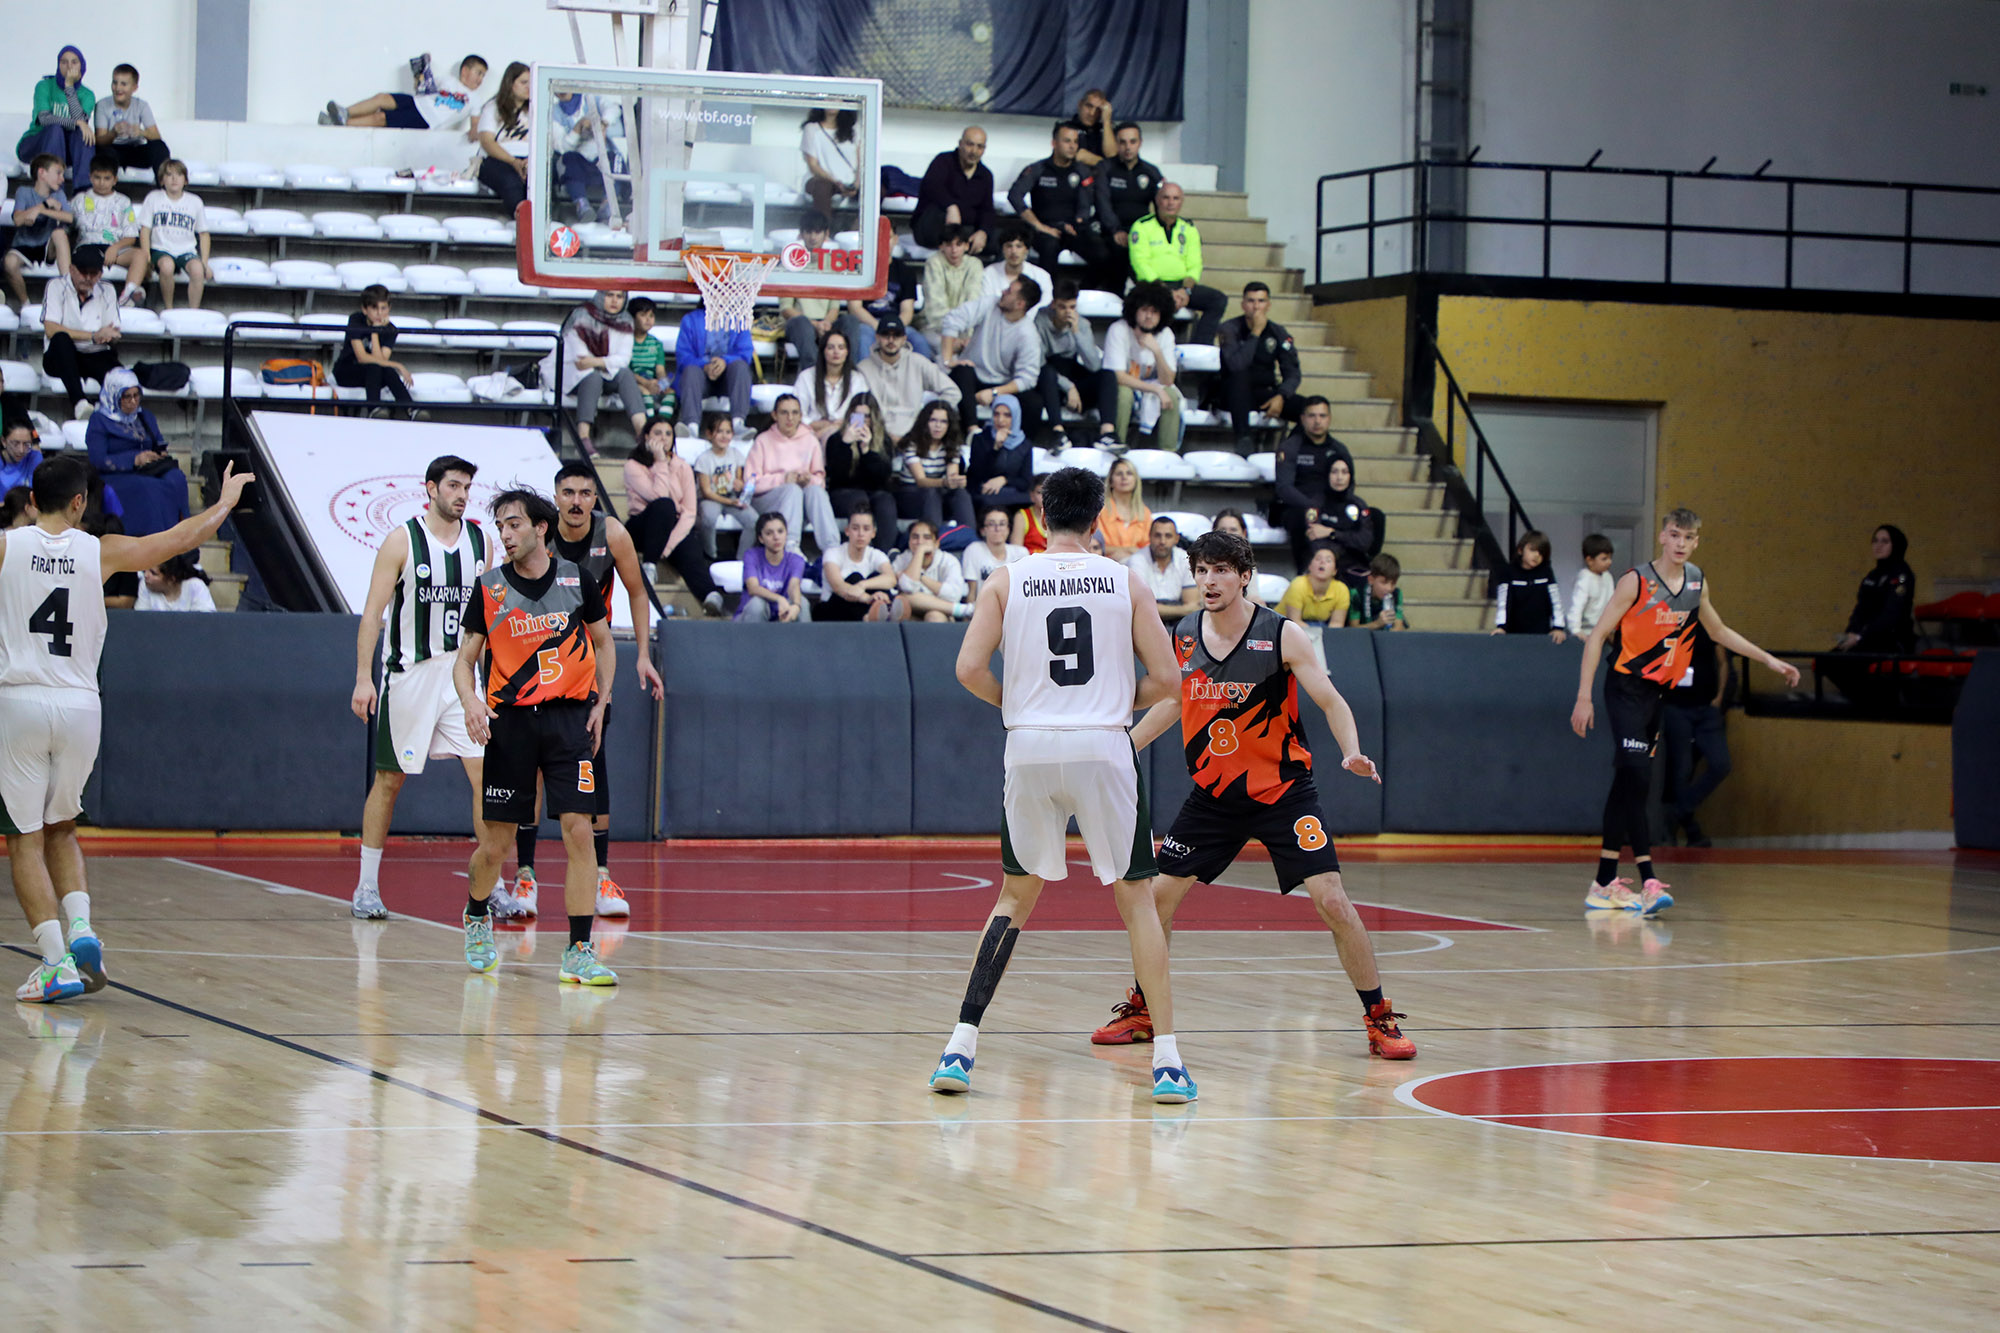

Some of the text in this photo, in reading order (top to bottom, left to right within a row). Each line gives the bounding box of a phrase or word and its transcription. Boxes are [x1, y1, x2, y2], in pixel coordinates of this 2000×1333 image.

[659, 110, 758, 127] www.tbf.org.tr
[812, 248, 864, 272] TBF
[31, 555, 75, 575] FIRAT TÖZ
[419, 586, 460, 603] SAKARYA
[1023, 576, 1115, 598] CİHAN AMASYALI
[29, 587, 74, 657] 4
[444, 609, 460, 635] 6
[508, 611, 569, 637] birey
[1046, 606, 1095, 687] 9
[1663, 638, 1678, 667] 7
[537, 647, 563, 685] 5
[1190, 677, 1256, 703] birey
[1208, 718, 1239, 757] 8
[578, 760, 595, 793] 5
[1293, 815, 1327, 851] 8
